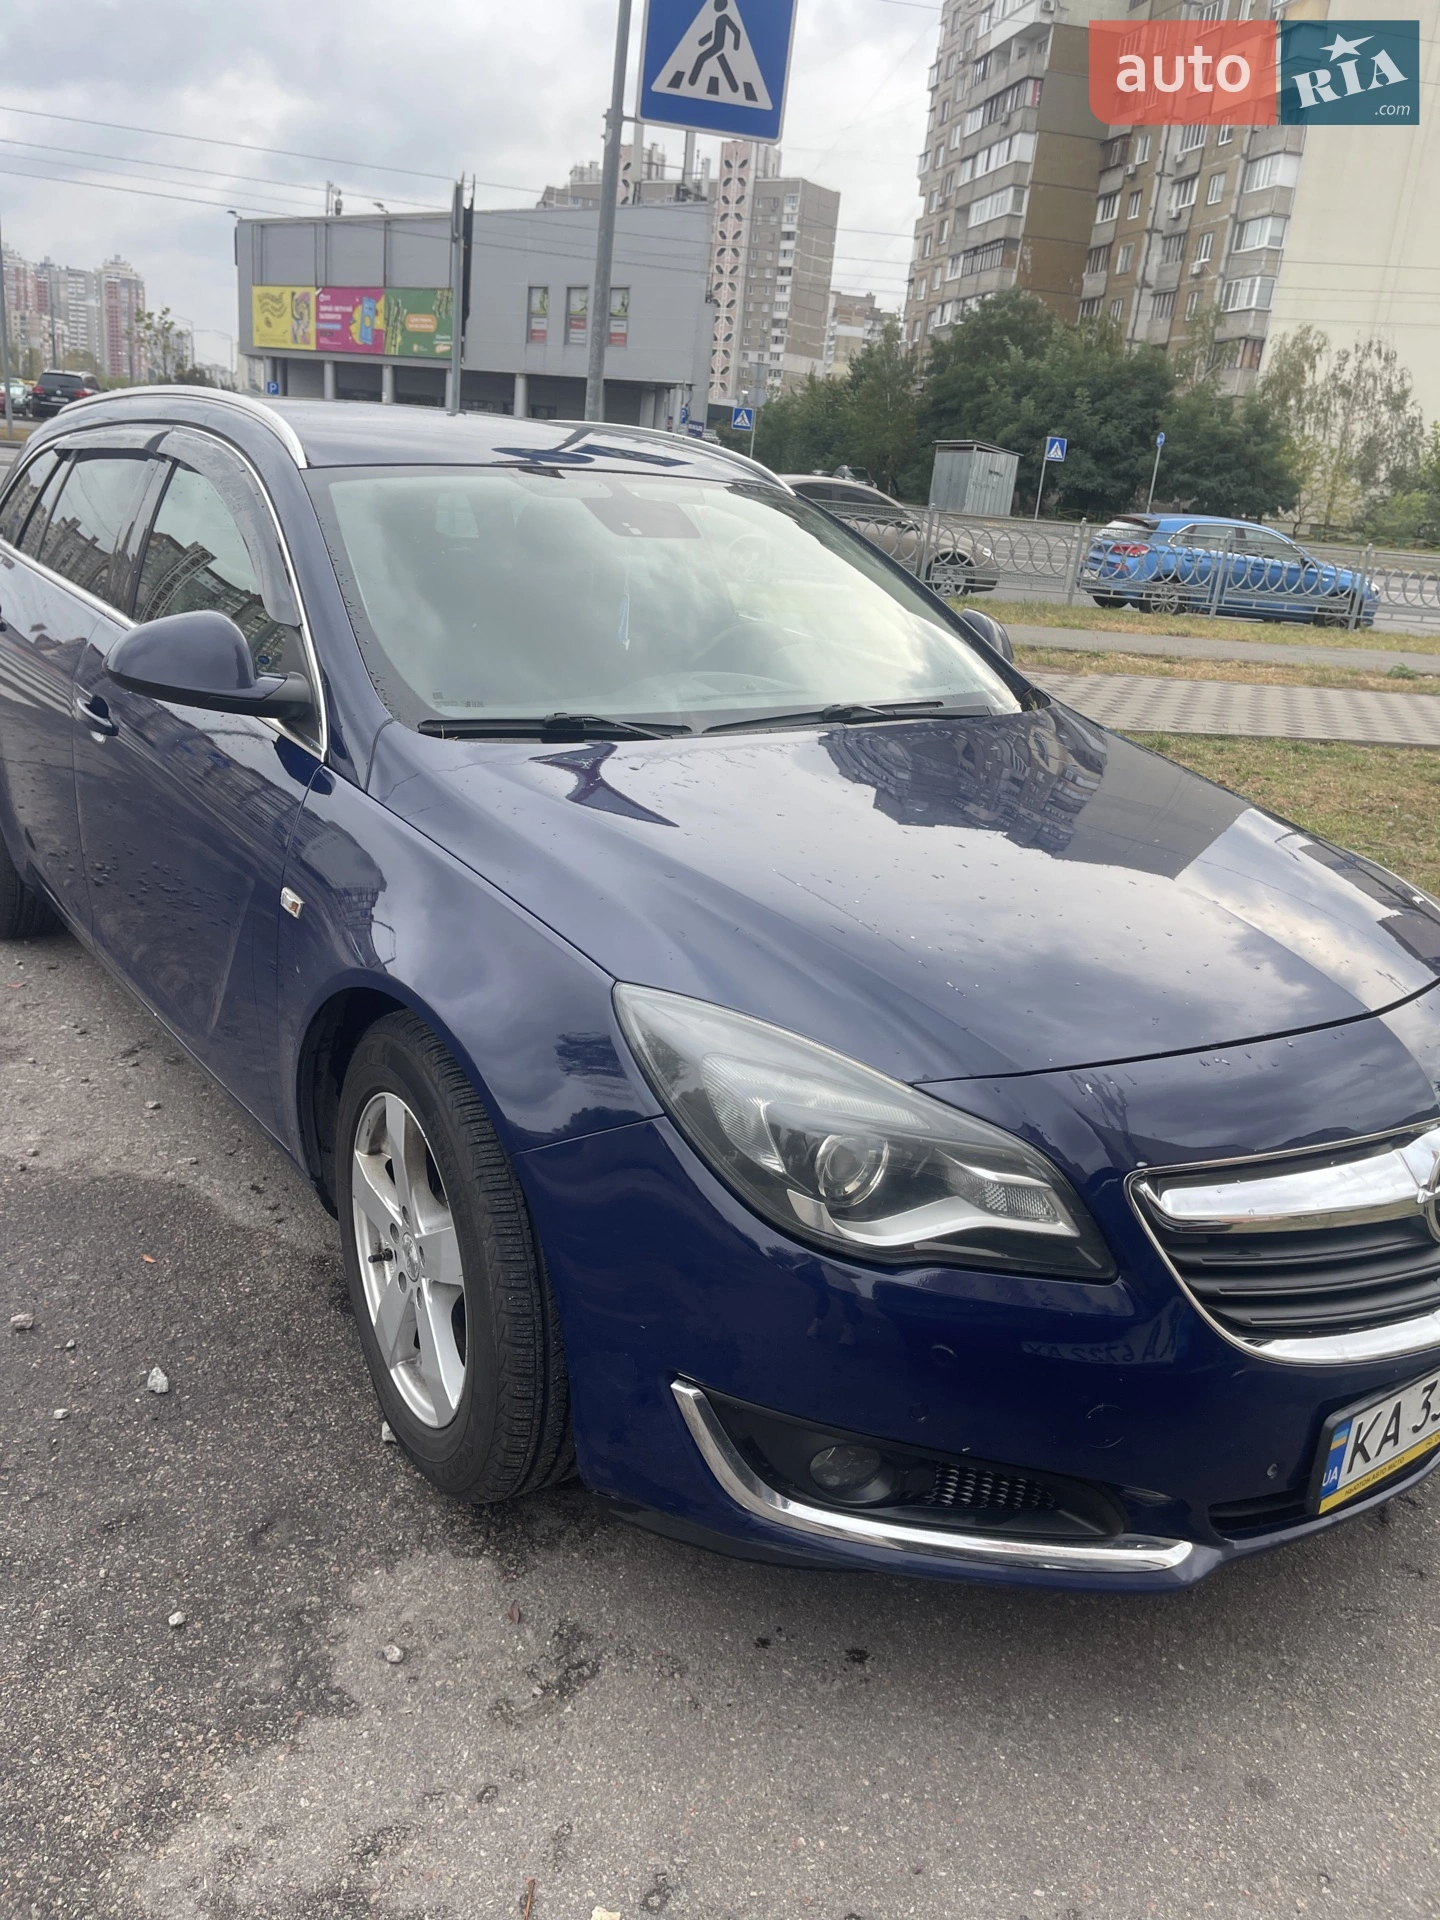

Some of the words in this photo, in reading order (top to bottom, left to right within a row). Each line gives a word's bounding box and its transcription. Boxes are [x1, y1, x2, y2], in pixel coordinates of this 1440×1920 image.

[269, 382, 277, 393] P
[1346, 1401, 1402, 1474] KA
[1412, 1379, 1440, 1434] 3
[1322, 1466, 1338, 1487] UA
[1344, 1478, 1371, 1496] НЬЮТОН
[1372, 1468, 1387, 1480] АВТО
[1388, 1457, 1405, 1471] МІСТО
